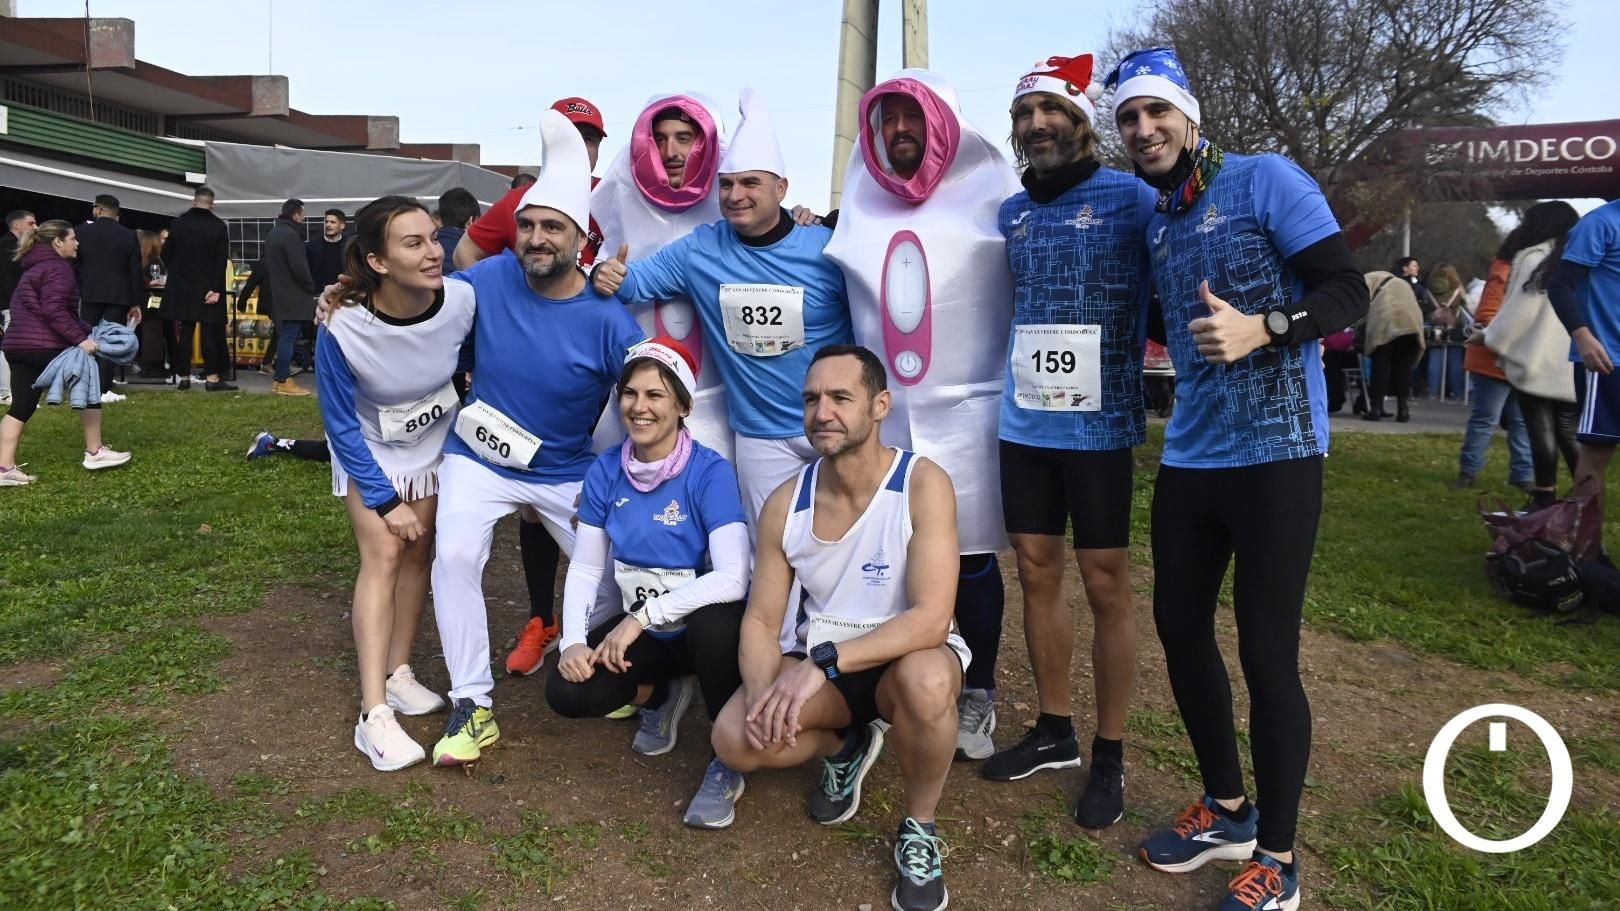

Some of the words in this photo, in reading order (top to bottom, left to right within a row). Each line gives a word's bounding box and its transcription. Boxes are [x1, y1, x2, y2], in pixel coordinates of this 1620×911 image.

[1467, 135, 1617, 163] IMDECO
[1525, 166, 1569, 177] Deportes
[1571, 165, 1613, 175] Córdoba
[742, 306, 783, 325] 832
[1032, 350, 1076, 374] 159
[405, 405, 443, 433] 800
[475, 426, 511, 459] 650
